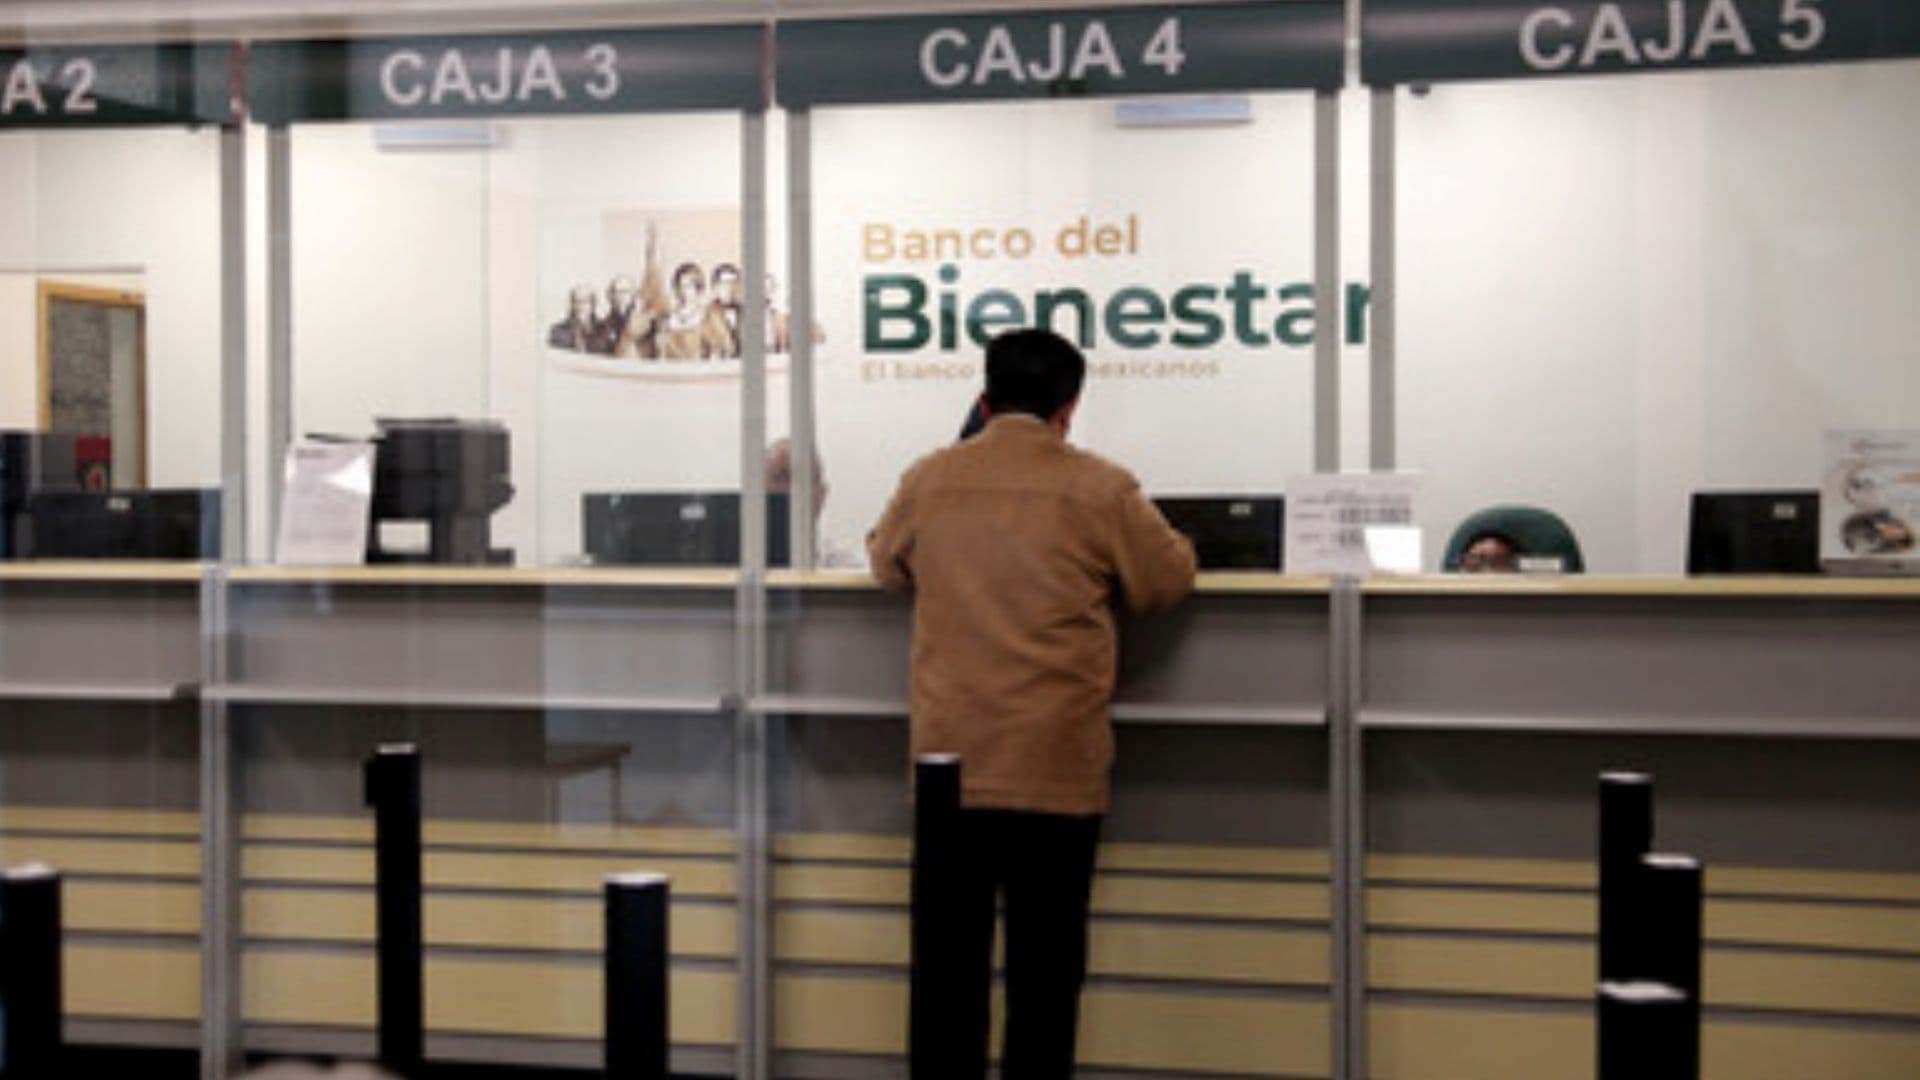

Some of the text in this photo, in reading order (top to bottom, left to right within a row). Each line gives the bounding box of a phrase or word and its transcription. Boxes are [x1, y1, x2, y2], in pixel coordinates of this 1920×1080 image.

[918, 16, 1187, 87] CAJA 4
[1517, 0, 1826, 71] CAJA 5
[62, 57, 98, 113] 2
[379, 42, 619, 106] CAJA 3
[862, 211, 1138, 262] Banco del
[862, 264, 1371, 353] Bienestar
[861, 359, 887, 383] El
[893, 360, 976, 381] banco
